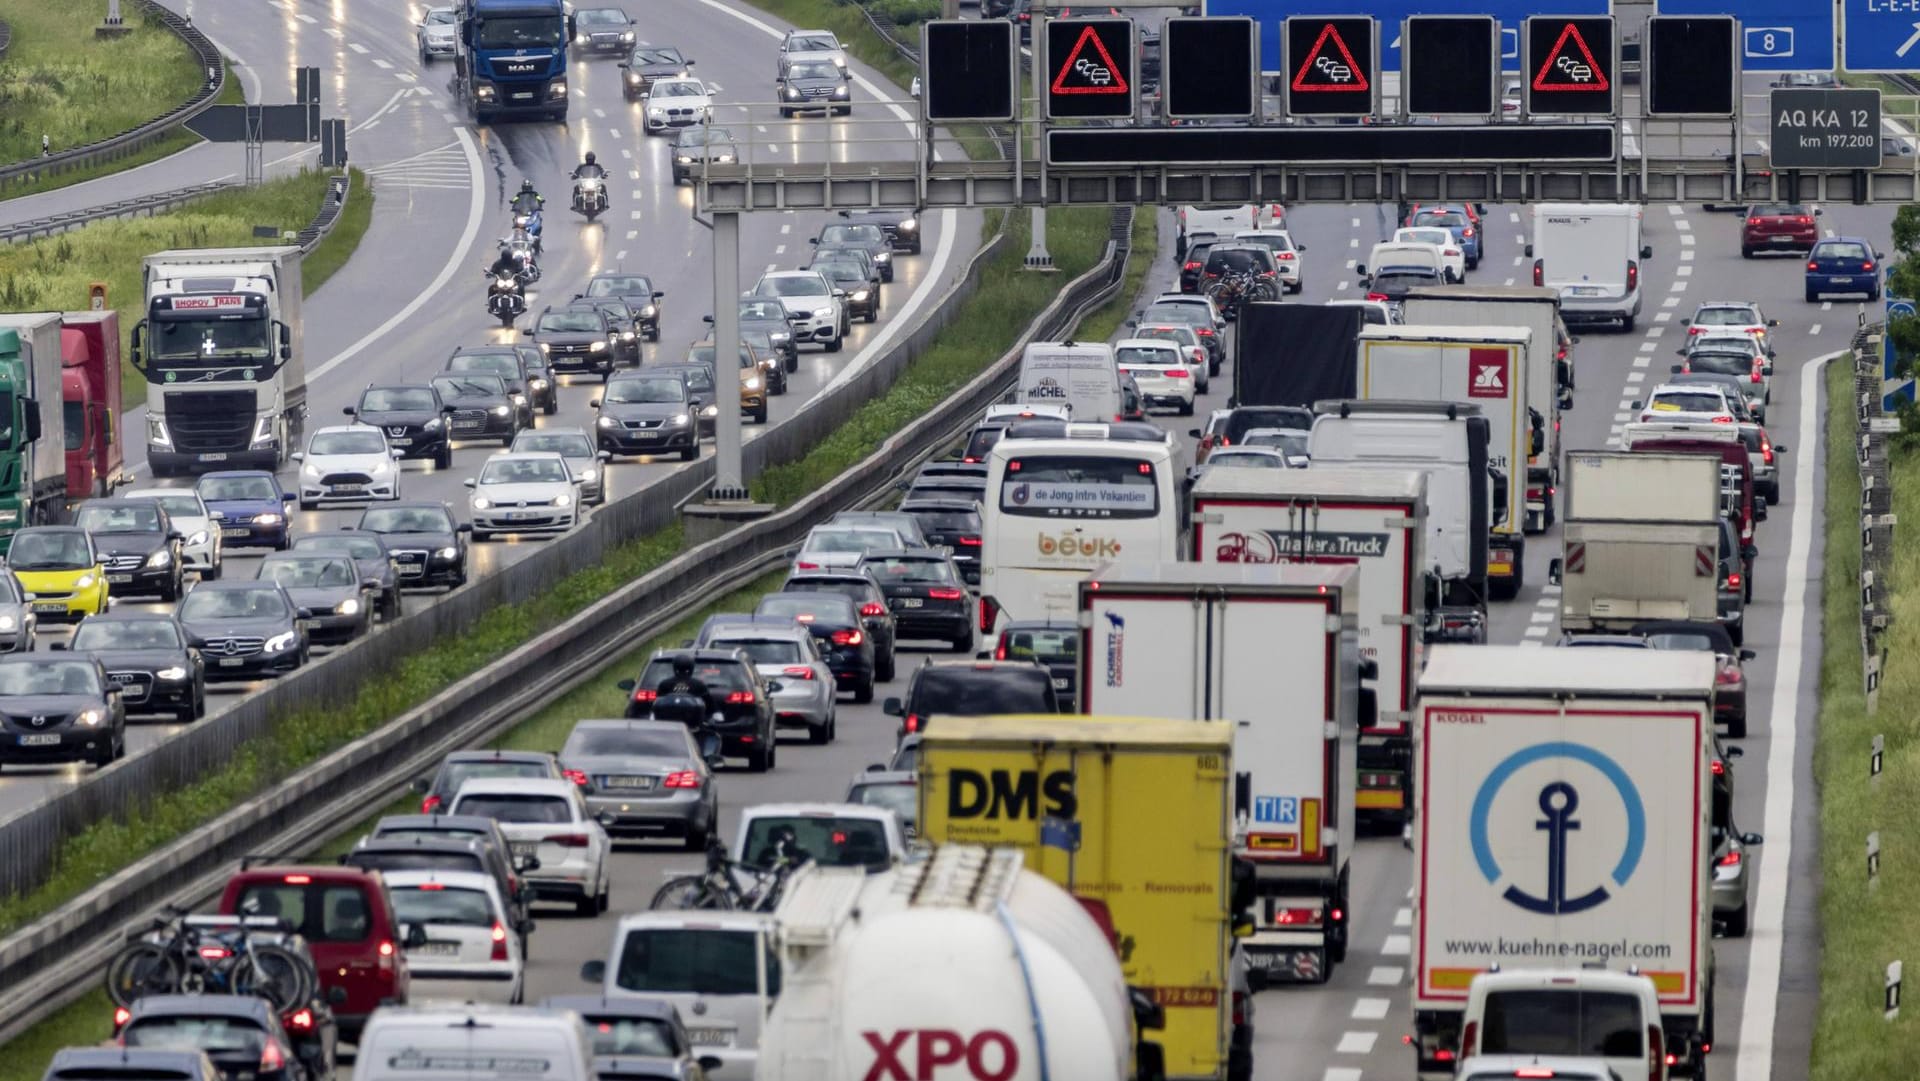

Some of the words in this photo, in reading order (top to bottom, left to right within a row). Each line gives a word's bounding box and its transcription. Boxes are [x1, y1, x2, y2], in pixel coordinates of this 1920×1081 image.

[1763, 33, 1775, 51] 8
[508, 64, 535, 72] MAN
[1777, 109, 1807, 128] AQ
[1812, 109, 1841, 128] KA
[1850, 109, 1869, 128] 12
[1800, 135, 1821, 148] km
[1827, 135, 1874, 148] 197.200
[175, 299, 209, 309] SHOPOV
[1028, 386, 1067, 398] MICHEL
[1036, 489, 1048, 500] de
[1050, 490, 1073, 503] Jong
[1100, 490, 1146, 502] Vakanties
[1278, 535, 1329, 553] Trailer
[1338, 536, 1382, 554] Truck
[1107, 632, 1116, 688] SCHMITZ
[948, 769, 1078, 820] DMS
[1257, 798, 1295, 821] TIR
[1145, 881, 1214, 894] Removals
[1445, 937, 1671, 960] www.kuehne-nagel.com
[860, 1029, 1020, 1081] XPO
